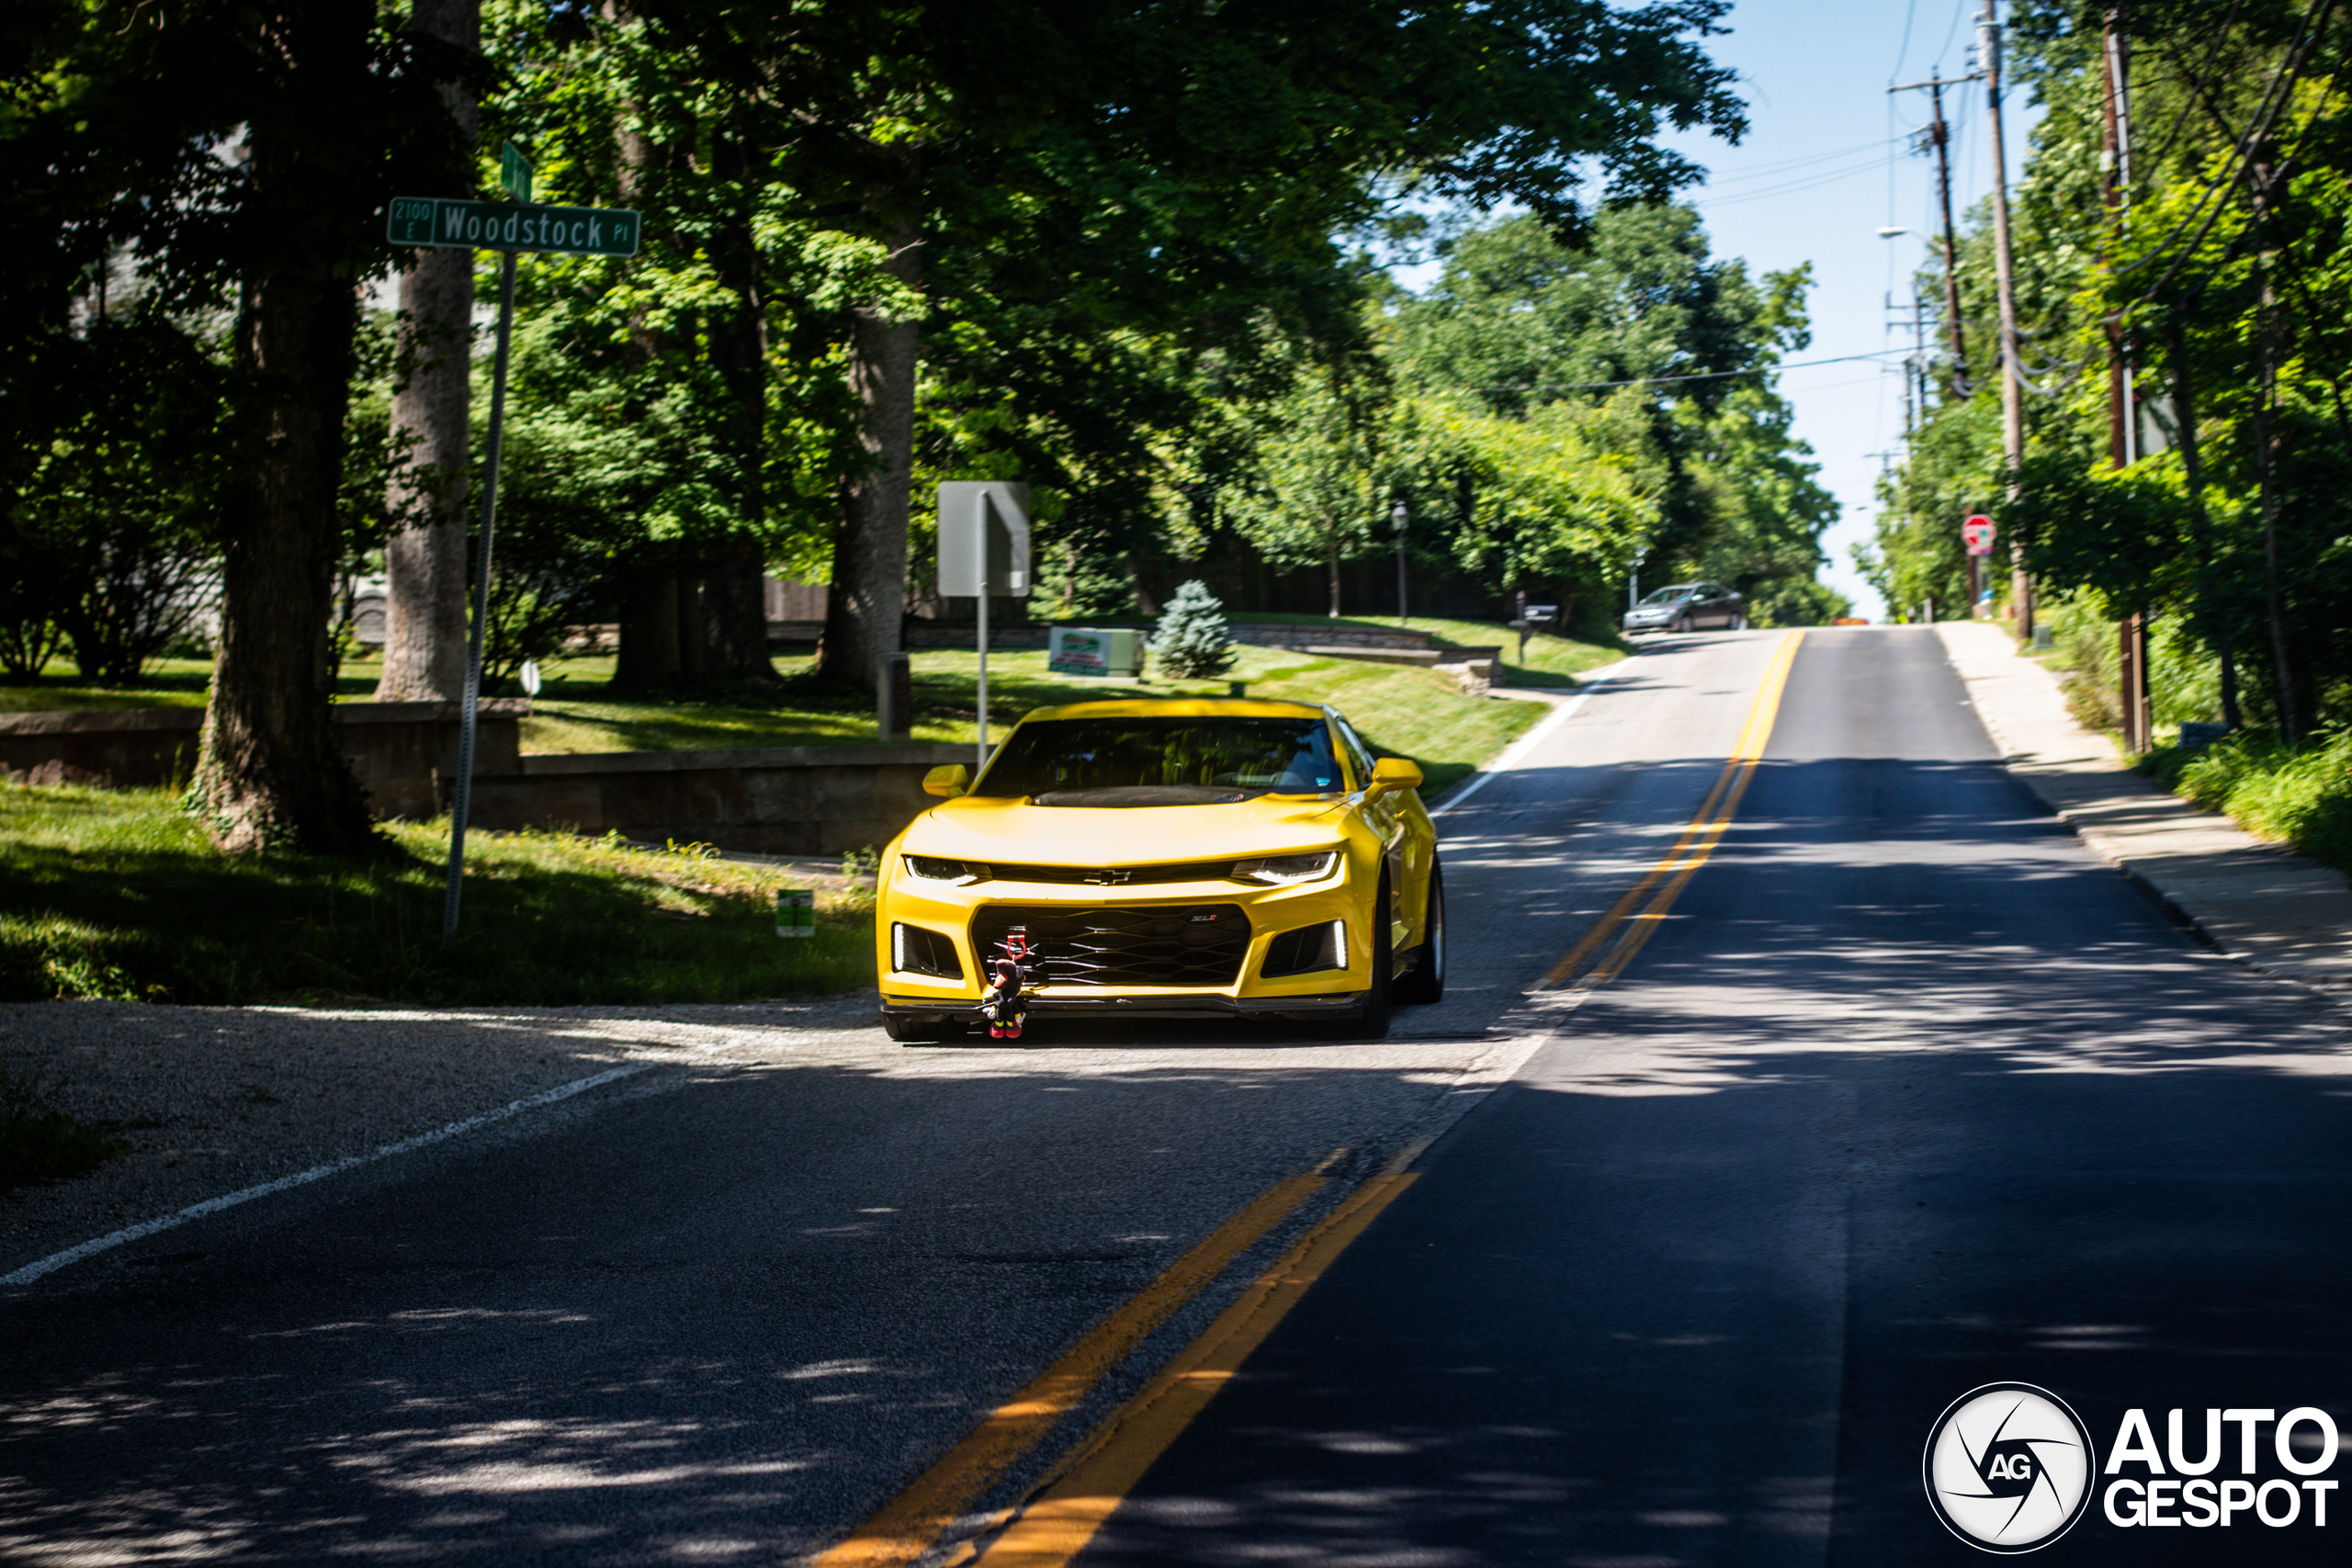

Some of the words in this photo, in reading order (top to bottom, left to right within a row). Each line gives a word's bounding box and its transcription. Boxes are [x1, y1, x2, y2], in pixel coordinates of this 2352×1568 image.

[395, 201, 431, 220] 2100
[406, 221, 416, 240] E
[446, 206, 603, 248] Woodstock
[1191, 914, 1217, 922] ZL1
